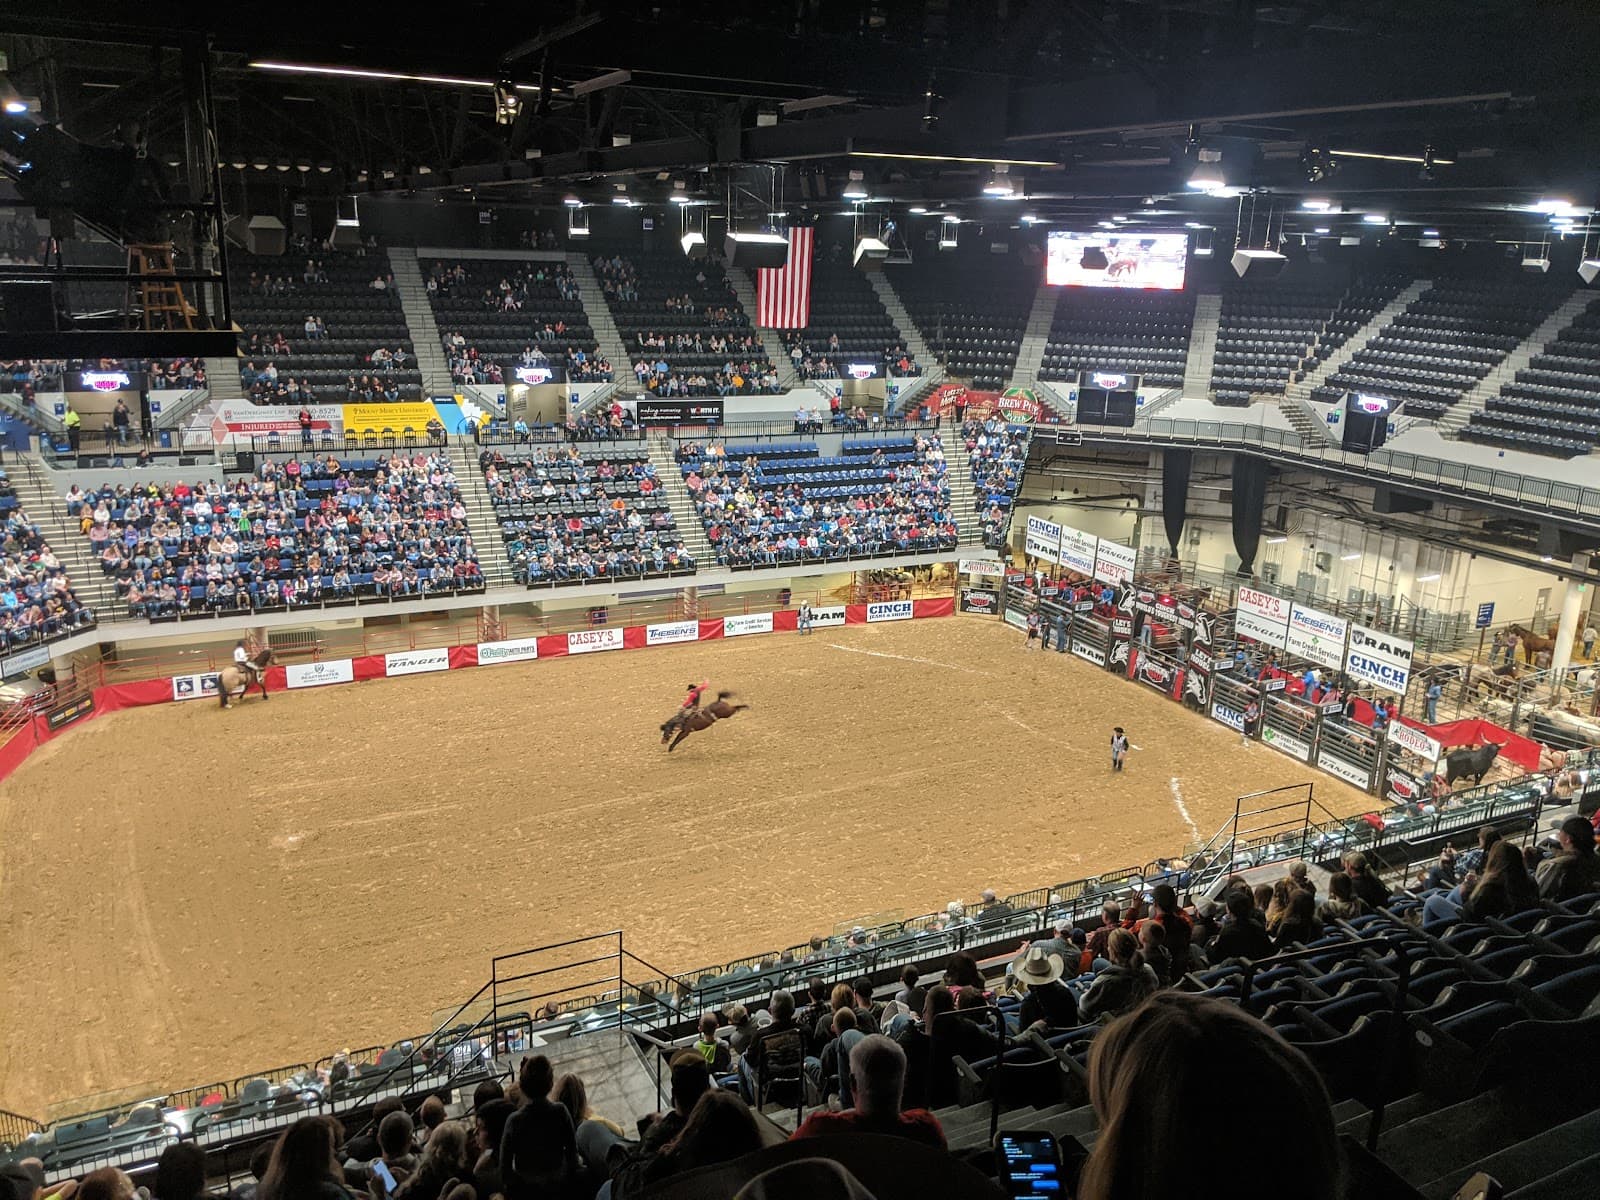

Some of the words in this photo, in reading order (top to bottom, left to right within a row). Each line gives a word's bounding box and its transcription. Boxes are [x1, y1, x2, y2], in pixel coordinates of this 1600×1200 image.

[998, 397, 1020, 409] BREW
[1029, 519, 1060, 536] CINCH
[1033, 543, 1058, 557] RAM
[1098, 547, 1134, 563] RANGER
[1097, 560, 1126, 579] CASEY'S
[870, 603, 911, 614] CINCH
[1240, 588, 1280, 612] CASEY'S
[810, 612, 844, 620] RAM
[1293, 610, 1343, 636] THEISEN'S
[570, 630, 614, 645] CASEY'S
[648, 627, 697, 638] THEISEN'S
[1237, 621, 1284, 640] RANGER
[1079, 645, 1104, 662] RAM
[1288, 636, 1301, 646] Farm
[1302, 641, 1317, 653] Credit
[1319, 647, 1341, 661] Services
[1306, 651, 1327, 664] America
[1365, 637, 1411, 660] RAM
[388, 657, 447, 668] RANGER
[1350, 654, 1405, 684] CINCH
[1348, 665, 1368, 678] JEANS
[1377, 675, 1403, 690] SHIRTS
[1216, 704, 1242, 724] CINC
[1399, 731, 1425, 750] RODEO
[1319, 759, 1367, 784] RANGER
